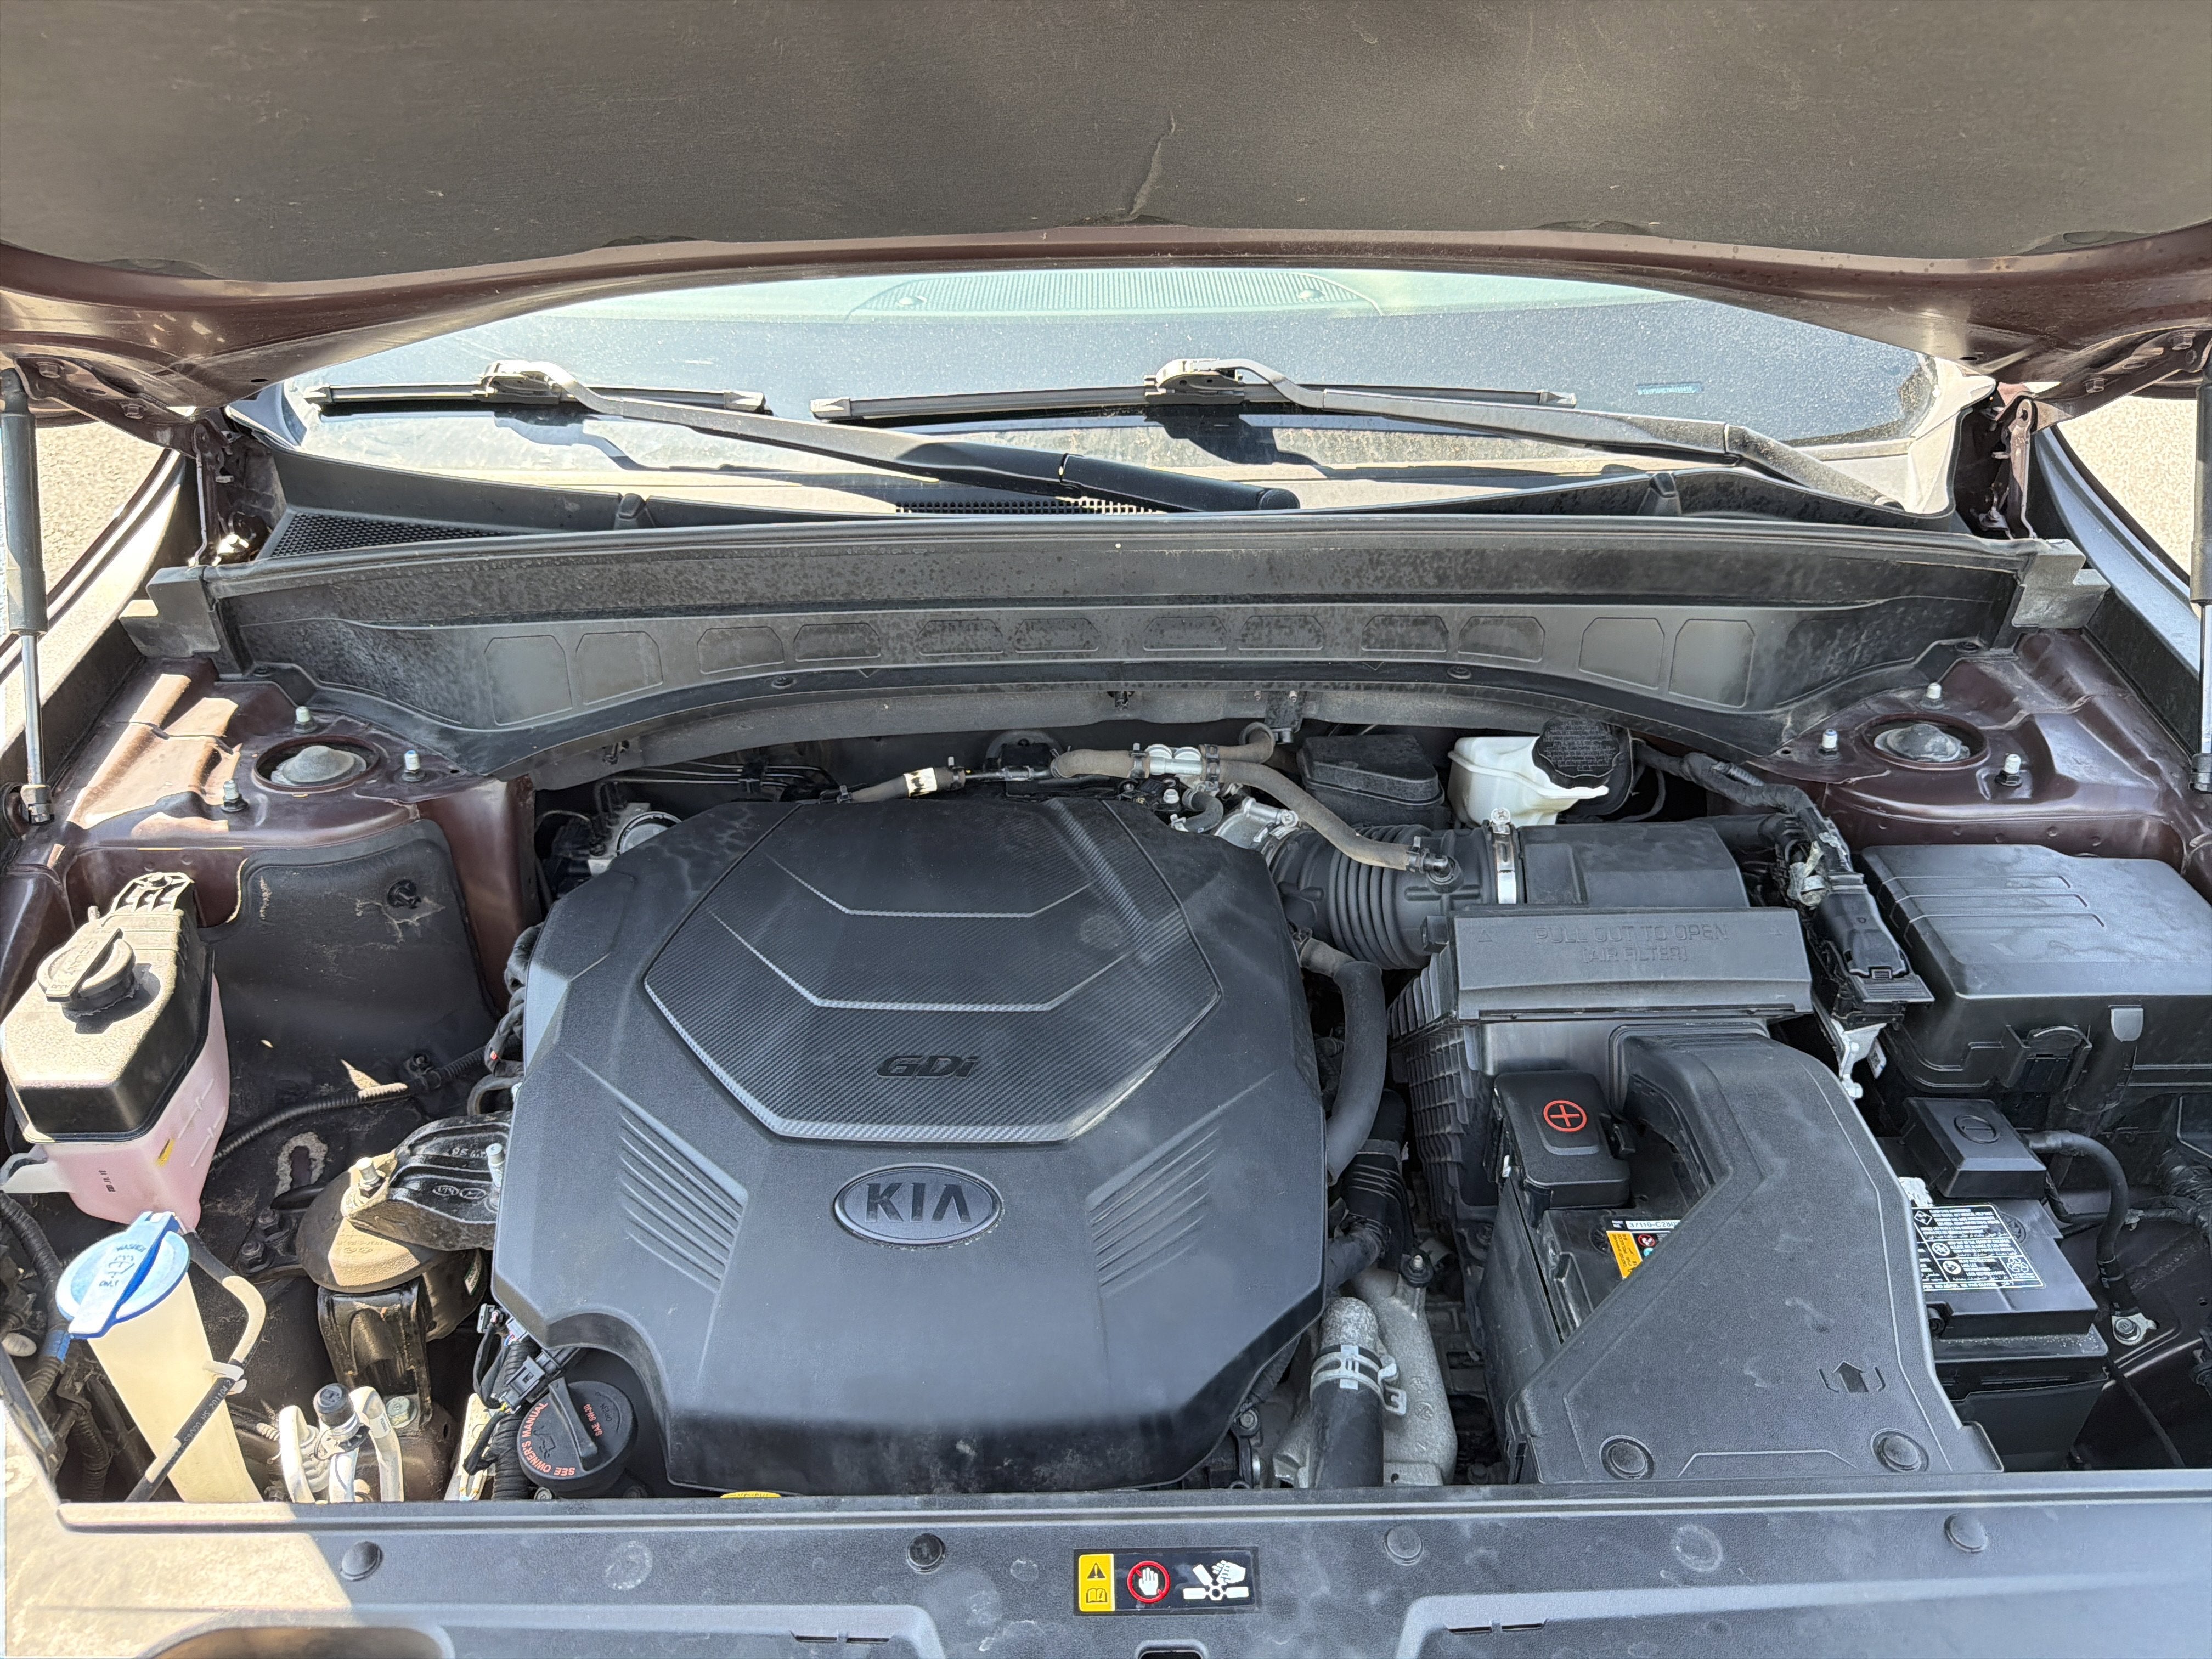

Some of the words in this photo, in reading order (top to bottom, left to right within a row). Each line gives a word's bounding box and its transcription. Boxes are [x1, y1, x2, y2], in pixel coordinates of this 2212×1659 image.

[1536, 927, 1588, 944] PULL
[1594, 926, 1634, 943] OUT
[1640, 925, 1667, 941] TO
[1674, 924, 1729, 941] OPEN
[876, 1054, 981, 1079] GDi
[865, 1182, 973, 1224] KIA
[521, 1402, 549, 1438] MANUAL
[600, 1402, 613, 1422] OPEN
[591, 1421, 603, 1437] SAE
[521, 1440, 552, 1474] OWNER'S
[553, 1467, 576, 1476] SEE
